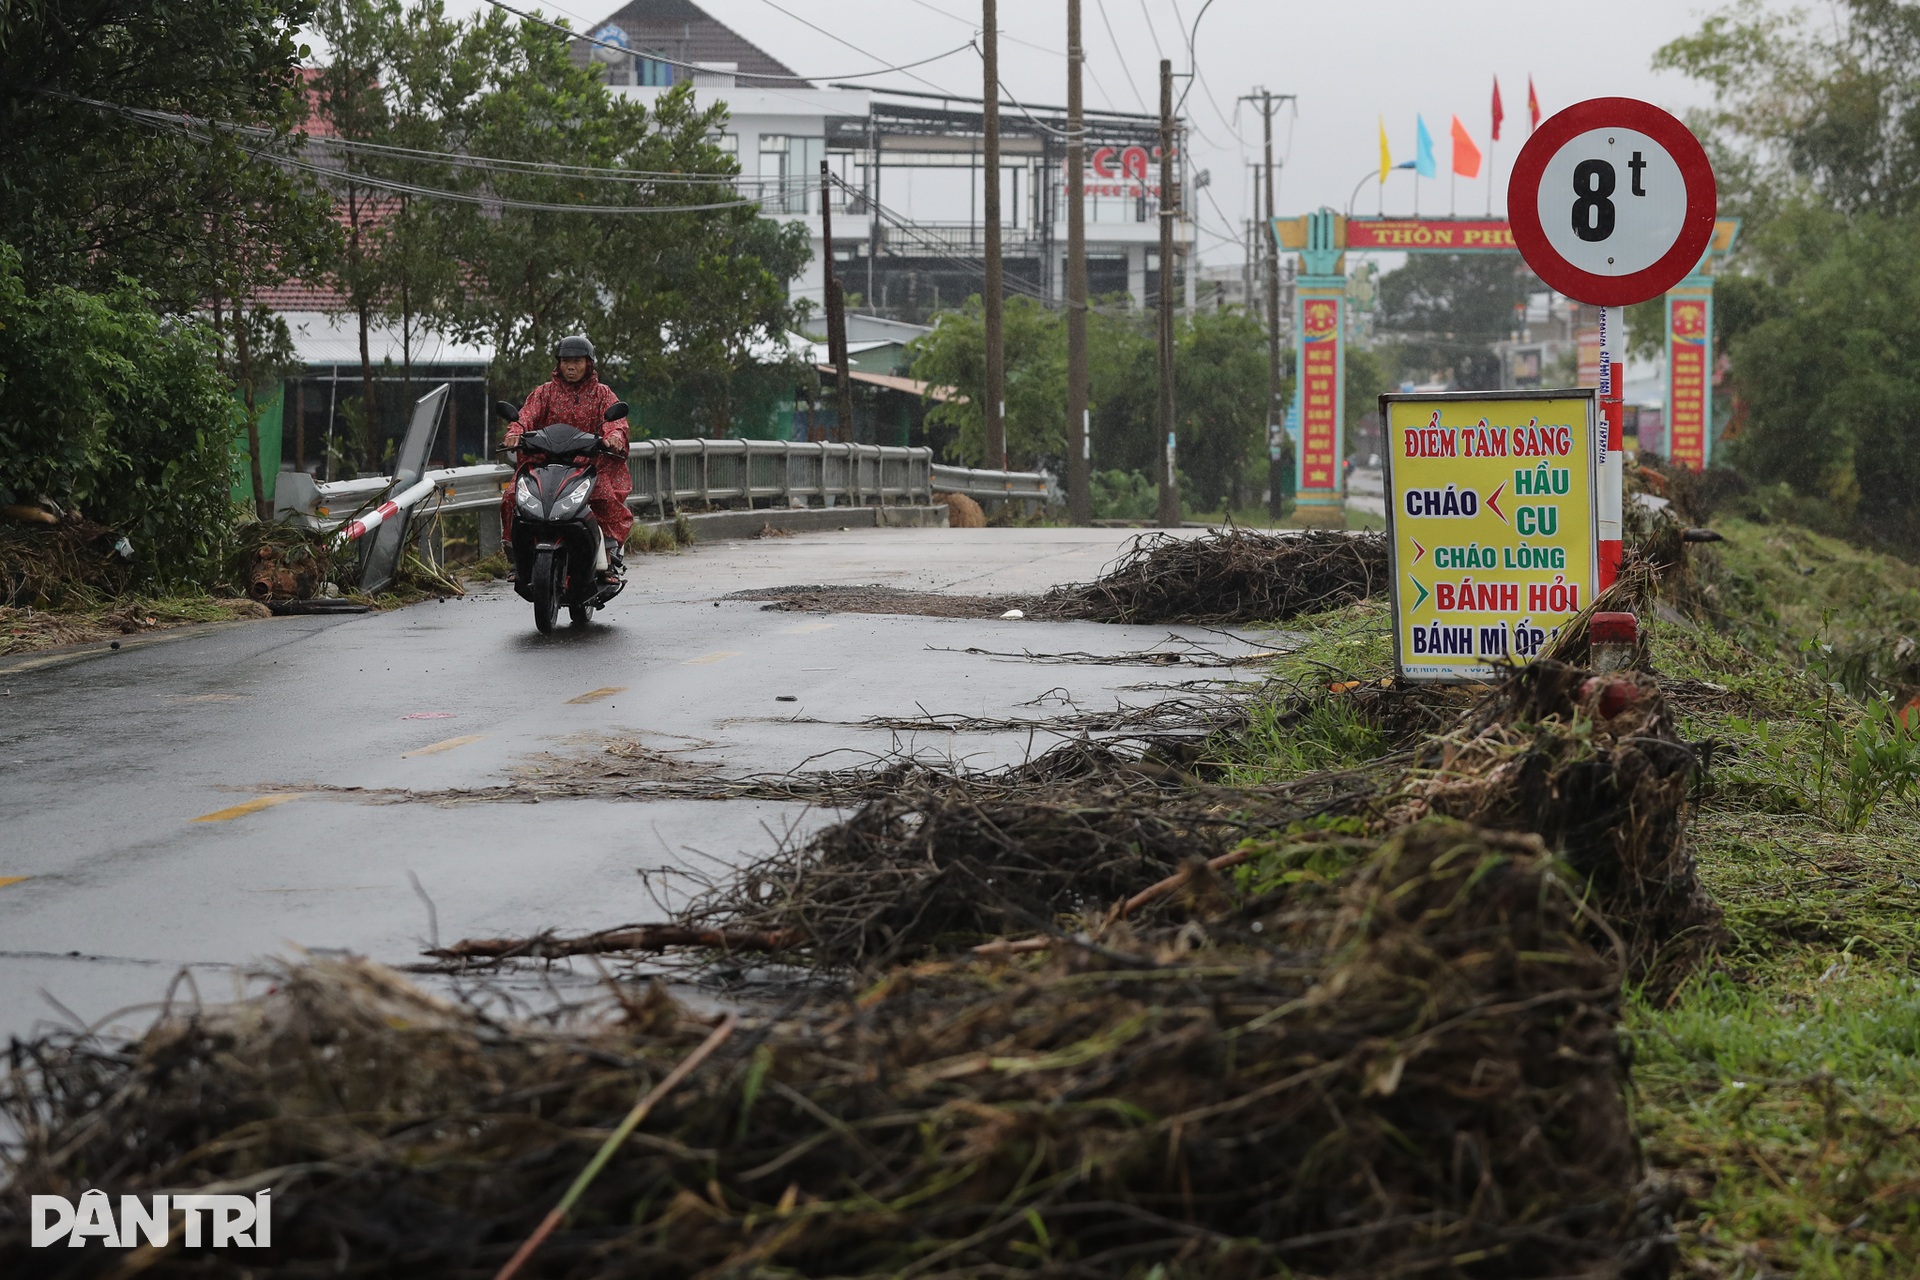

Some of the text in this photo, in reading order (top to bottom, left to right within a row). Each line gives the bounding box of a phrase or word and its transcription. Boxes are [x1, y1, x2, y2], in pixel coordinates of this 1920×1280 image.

[1373, 226, 1453, 244] THÔN
[1404, 411, 1572, 457] ĐIỂM TÂM SÁNG
[1515, 461, 1569, 495] HẦU
[1406, 486, 1477, 516] CHÁO
[1517, 507, 1557, 535] CU
[1435, 543, 1565, 568] CHÁO LÒNG
[1436, 576, 1578, 612] BÁNH HỎI
[1413, 622, 1473, 654] BÁNH
[1481, 622, 1507, 655] MÌ
[1515, 619, 1545, 655] ỐP
